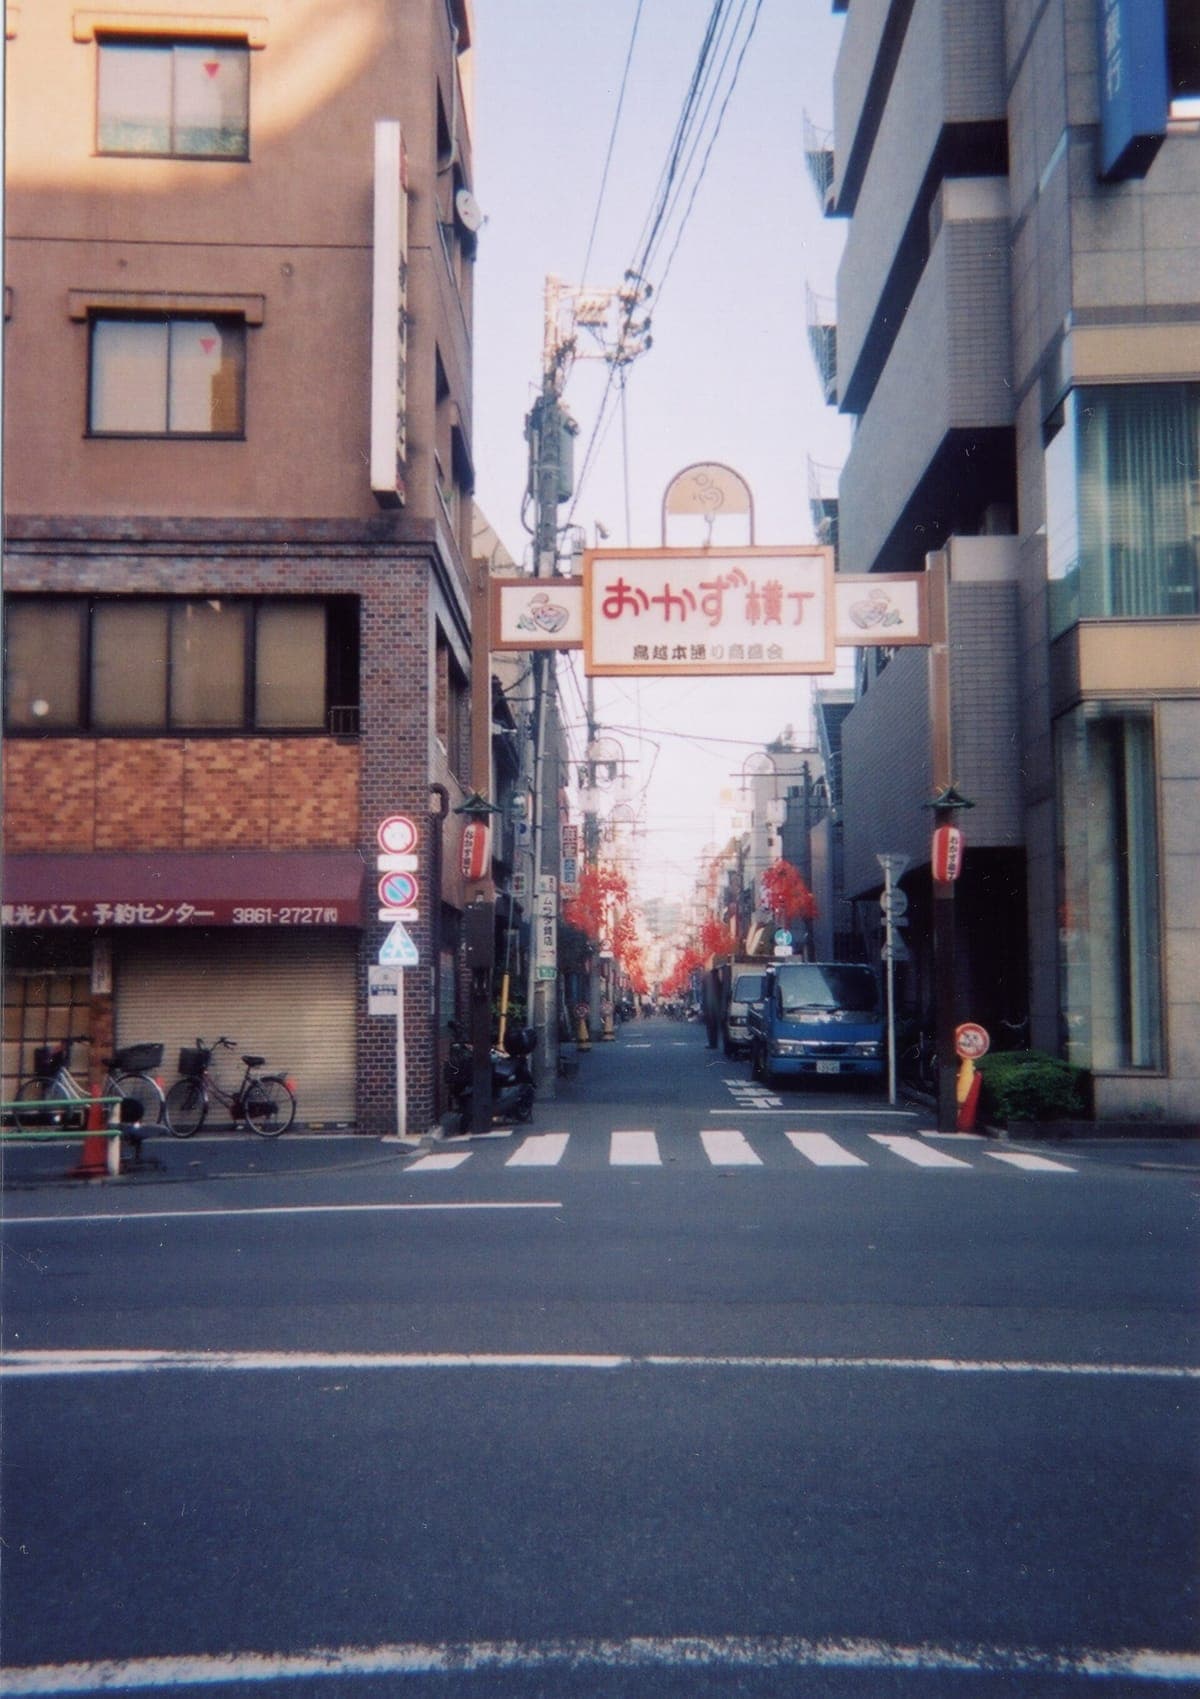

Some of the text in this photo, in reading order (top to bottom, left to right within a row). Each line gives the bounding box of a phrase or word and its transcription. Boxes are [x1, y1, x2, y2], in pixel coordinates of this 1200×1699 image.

[602, 566, 815, 627] おかず横丁
